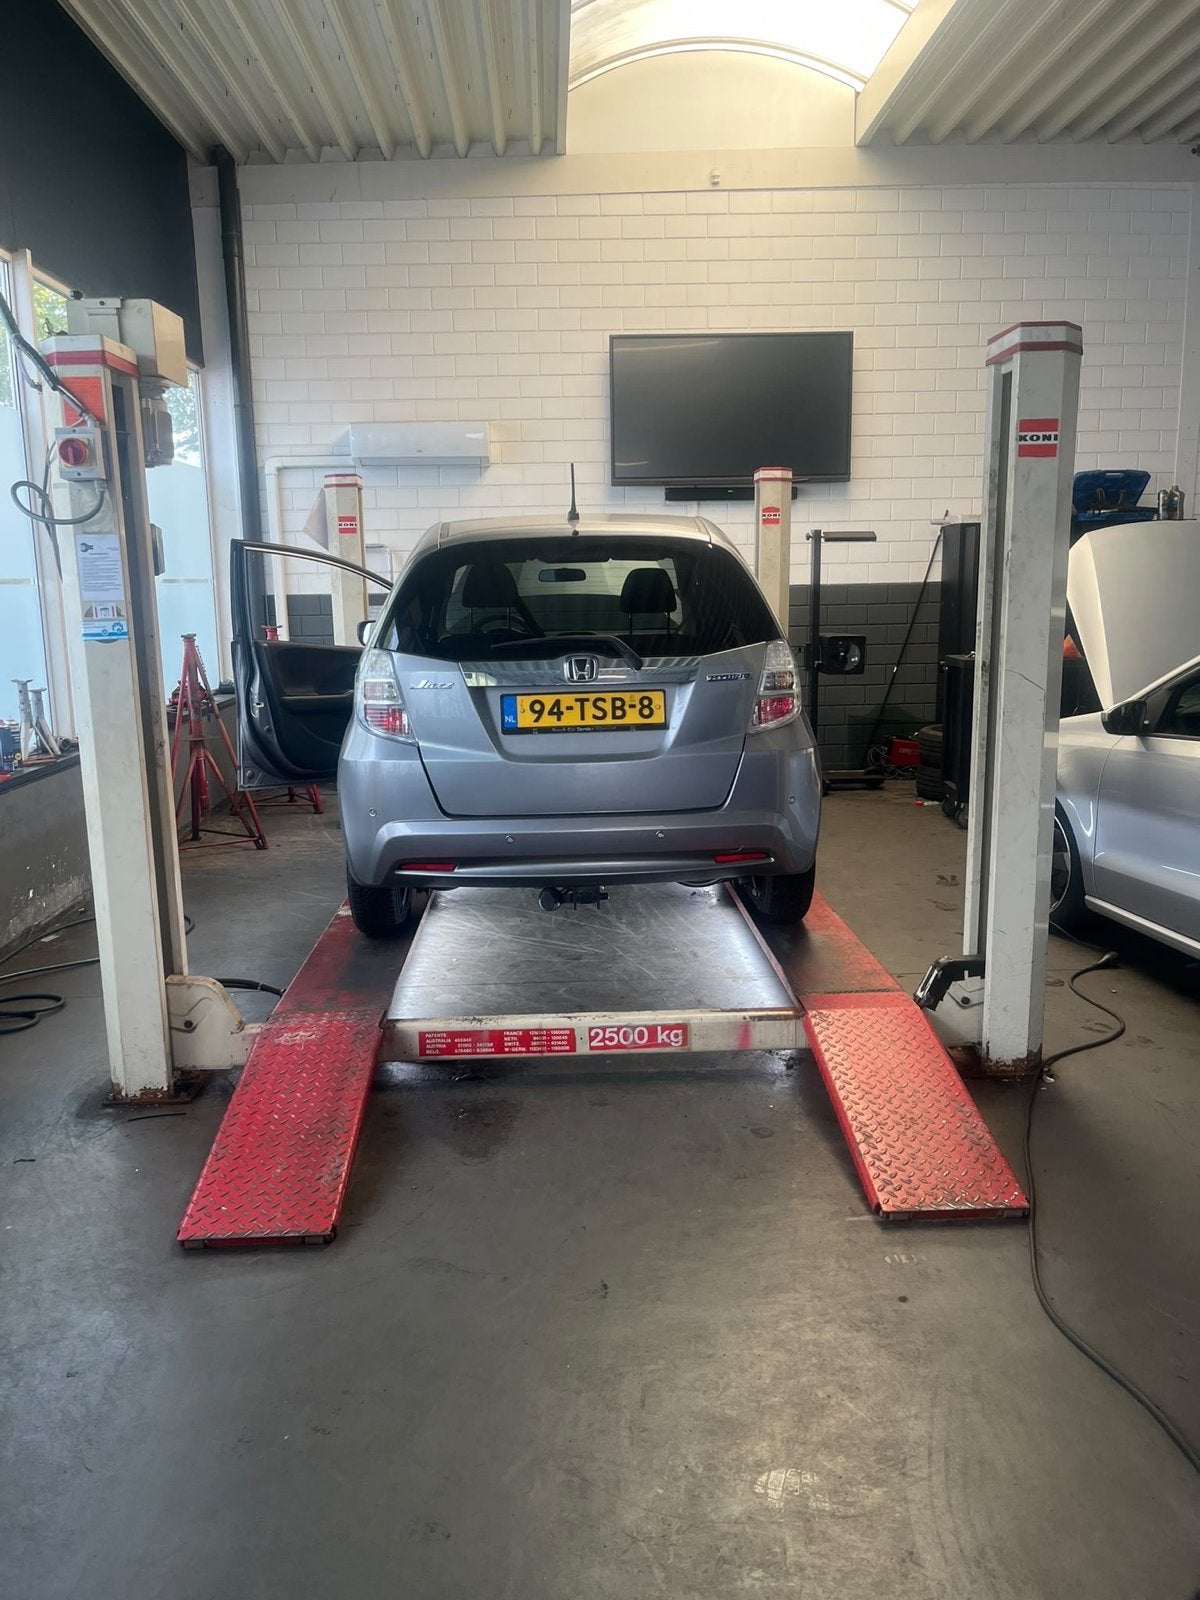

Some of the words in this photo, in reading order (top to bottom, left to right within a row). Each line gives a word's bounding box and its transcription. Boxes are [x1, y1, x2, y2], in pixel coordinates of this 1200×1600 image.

[1018, 434, 1059, 442] KONI
[529, 695, 655, 723] 94-TSB-8
[504, 715, 517, 723] NL
[590, 1027, 649, 1047] 2500
[657, 1026, 683, 1047] kg
